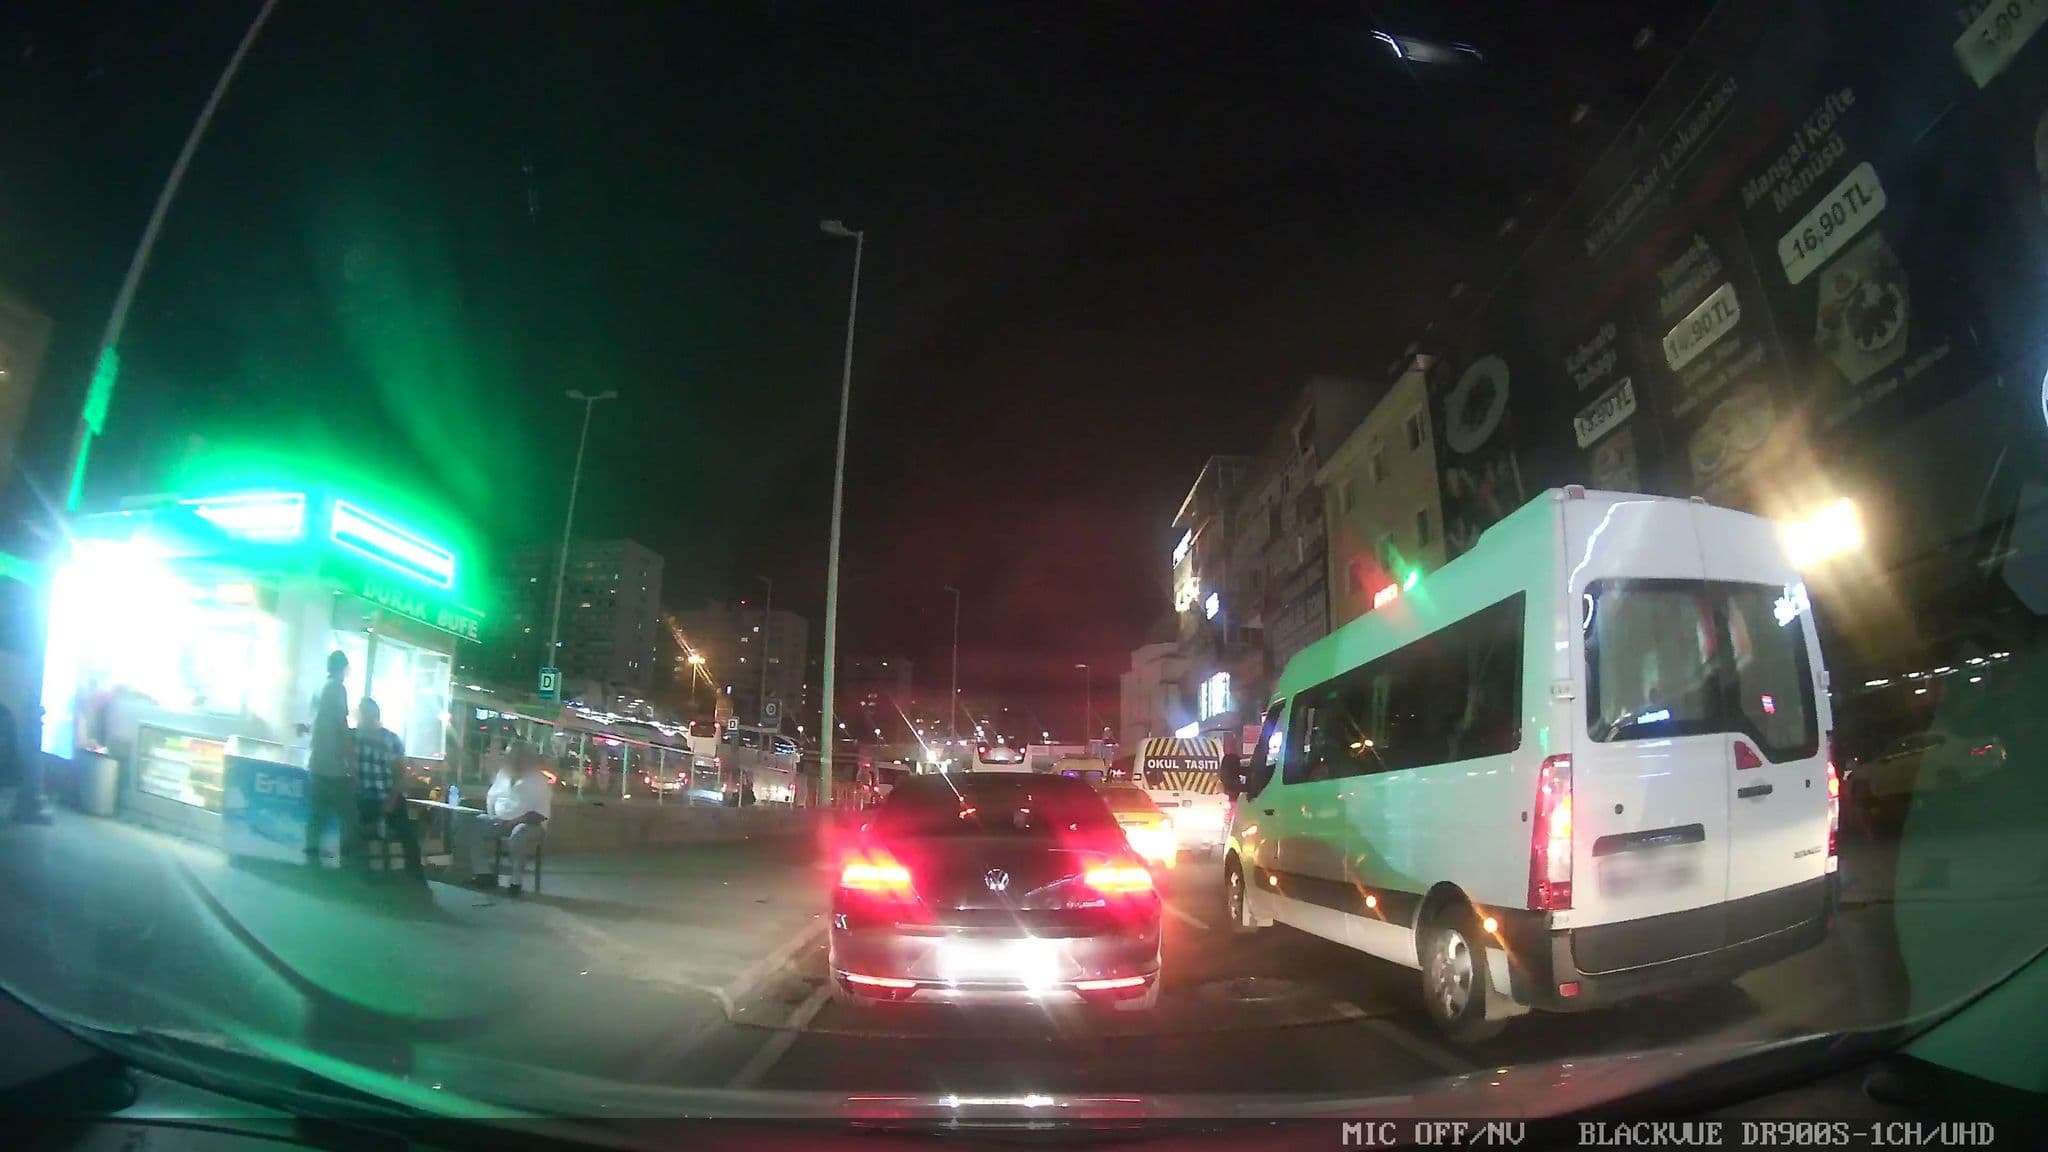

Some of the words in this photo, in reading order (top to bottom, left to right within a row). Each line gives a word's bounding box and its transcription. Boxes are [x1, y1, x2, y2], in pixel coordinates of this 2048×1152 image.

[1740, 131, 1806, 211] Mangal
[543, 675, 552, 688] D
[1147, 759, 1180, 769] OKUL
[1184, 759, 1219, 771] TAŞITI
